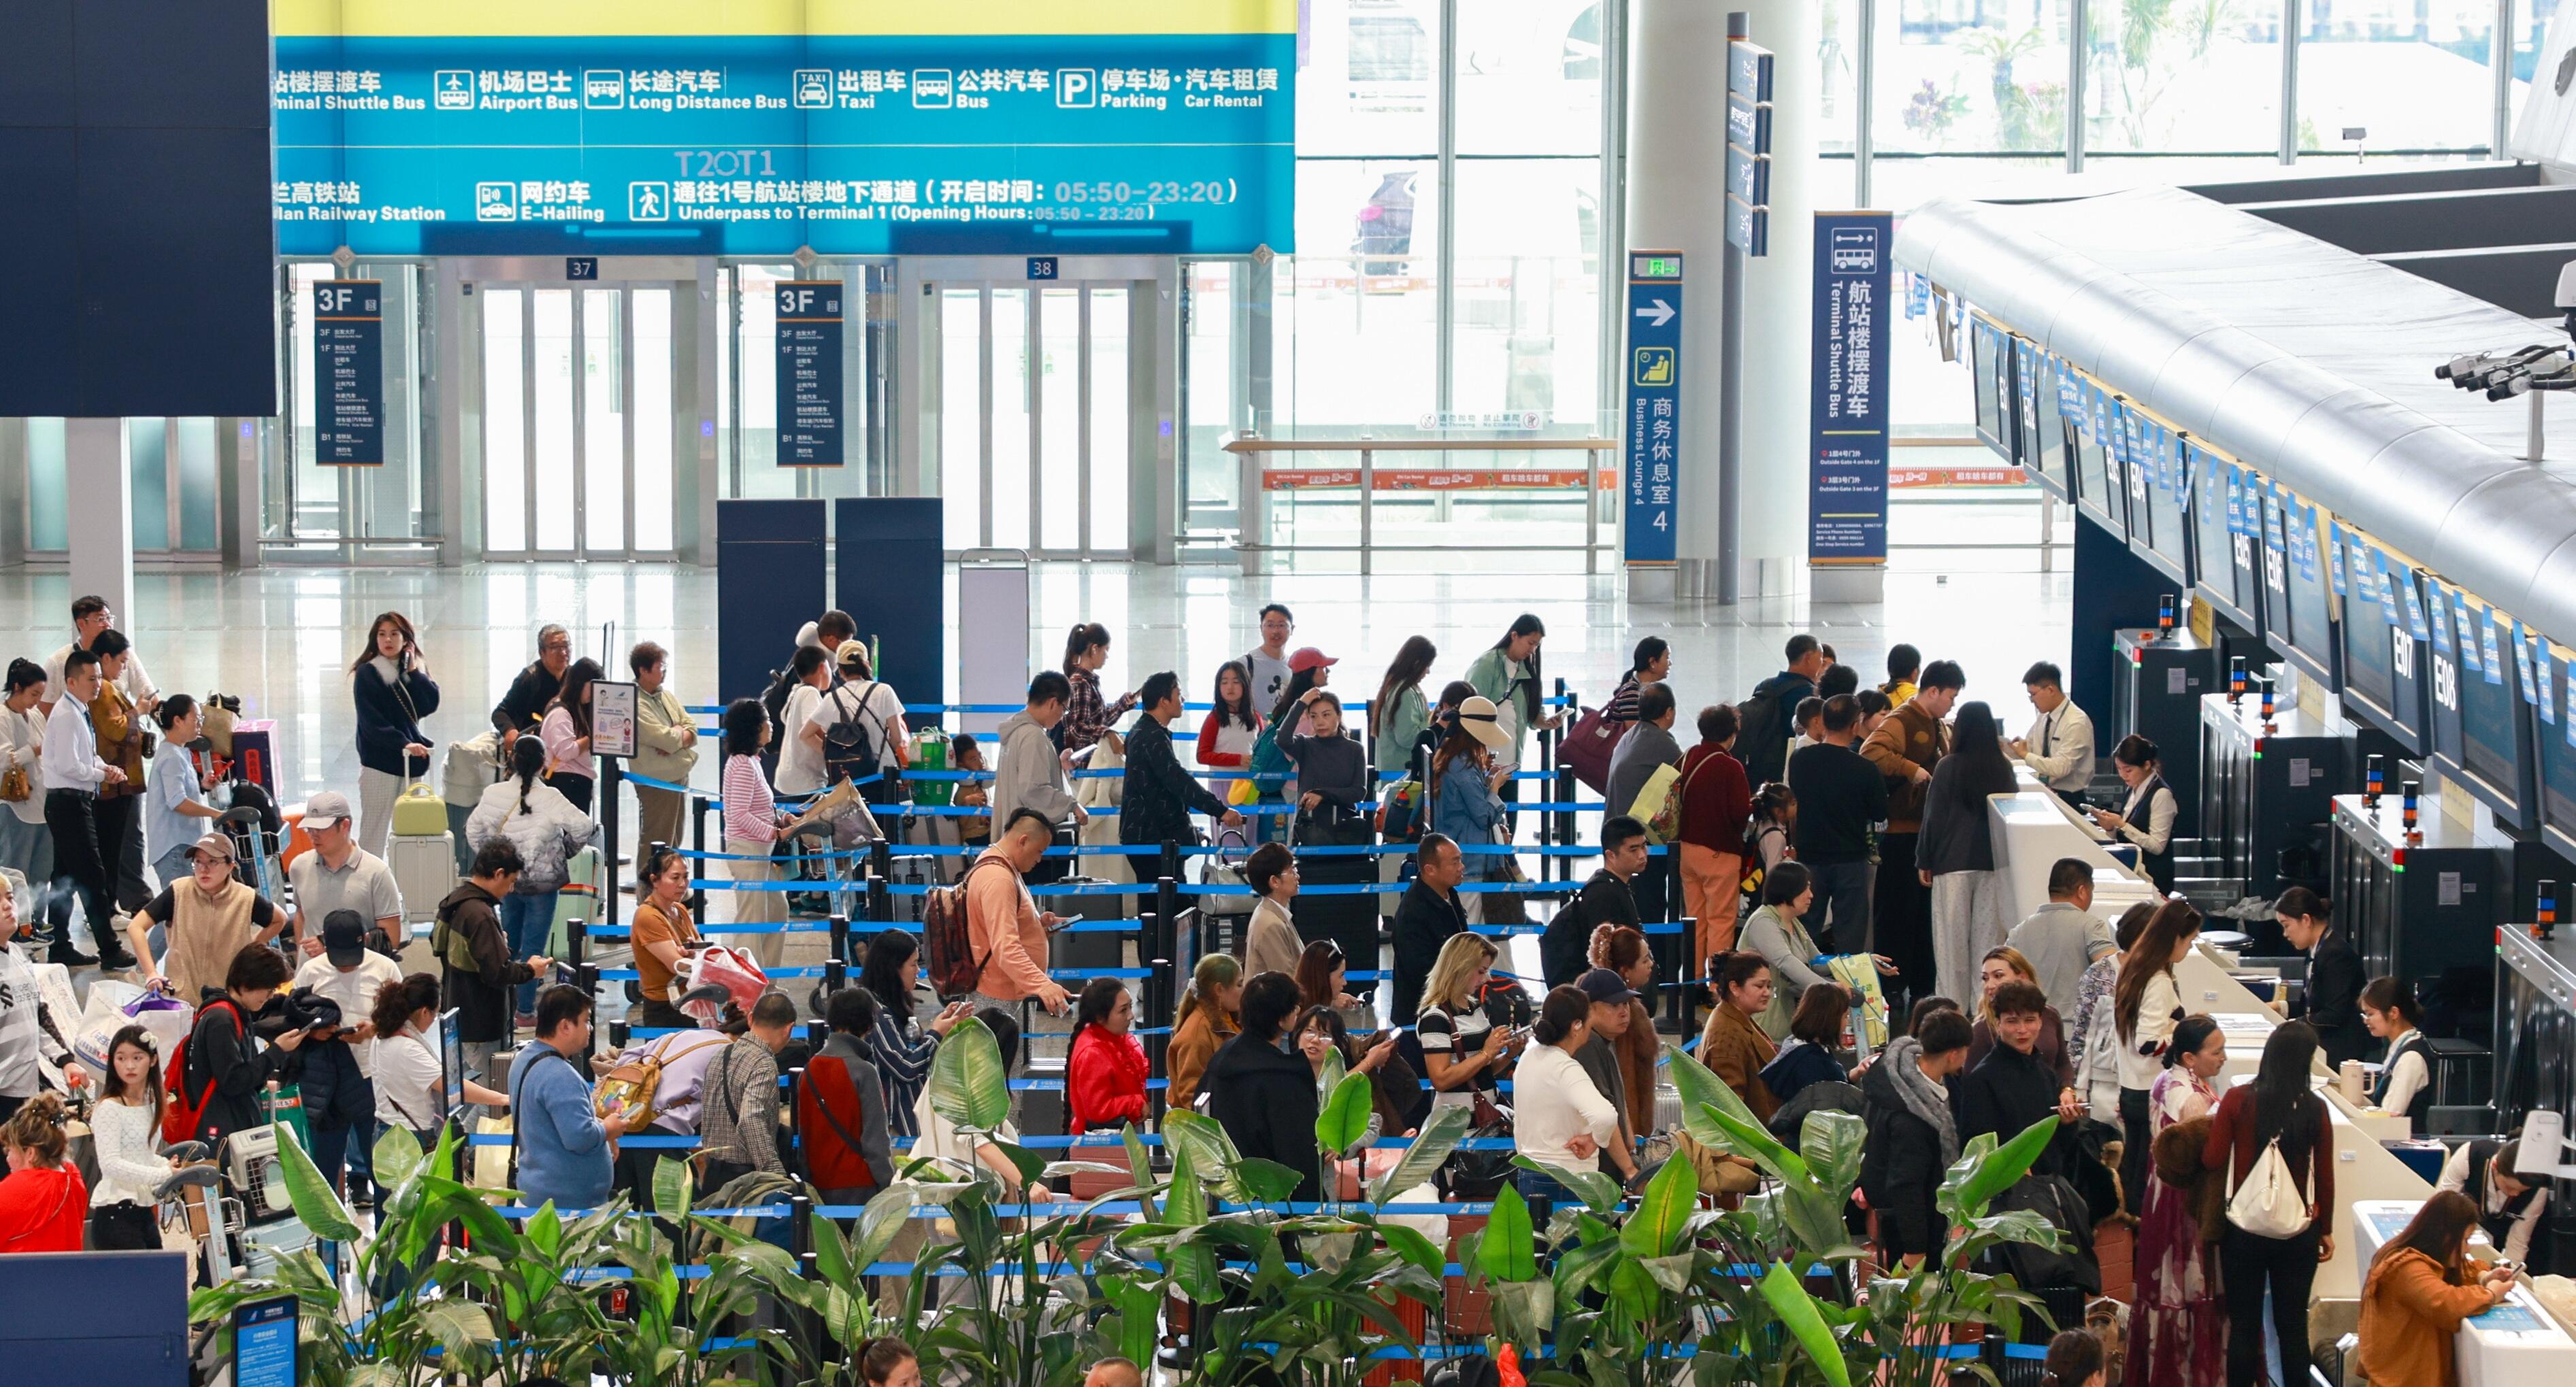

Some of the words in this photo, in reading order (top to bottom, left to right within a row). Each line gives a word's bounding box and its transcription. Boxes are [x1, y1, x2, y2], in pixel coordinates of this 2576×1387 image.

[478, 70, 572, 93] 机场巴士
[628, 69, 721, 93] 长途汽车
[838, 69, 907, 93] 出租车
[957, 69, 1050, 92] 公共汽车
[325, 96, 389, 110] Shuttle
[393, 96, 425, 110] Bus
[479, 95, 543, 113] Airport
[546, 95, 579, 110] Bus
[629, 95, 673, 112] Long
[676, 94, 752, 109] Distance
[755, 94, 787, 109] Bus
[838, 94, 875, 109] Taxi
[956, 93, 989, 108] Bus
[1100, 93, 1167, 111] Parking
[1185, 94, 1211, 107] Car
[1213, 94, 1263, 107] Rental
[521, 180, 591, 204] 网约车
[308, 207, 377, 223] Railway
[381, 206, 446, 220] Station
[521, 205, 605, 222] E-Hailing
[678, 205, 770, 222] Underpass
[774, 207, 791, 219] to
[796, 205, 874, 219] Terminal
[878, 205, 885, 219] 1
[891, 205, 971, 222] (Opening
[574, 263, 590, 275] 37
[1034, 262, 1051, 275] 38
[318, 288, 352, 311] 3F
[780, 290, 814, 312] 3F
[1830, 282, 1843, 339] Terminal
[1847, 280, 1871, 418] 航站楼摆渡车
[1830, 341, 1842, 391] Shuttle
[1829, 394, 1840, 418] Bus
[1635, 398, 1647, 450] Business
[1633, 454, 1645, 493] Lounge
[2130, 461, 2145, 502] E04
[2234, 532, 2250, 570] E05
[2266, 545, 2283, 593] E06
[2393, 626, 2413, 679] E07
[2434, 654, 2457, 711] E08
